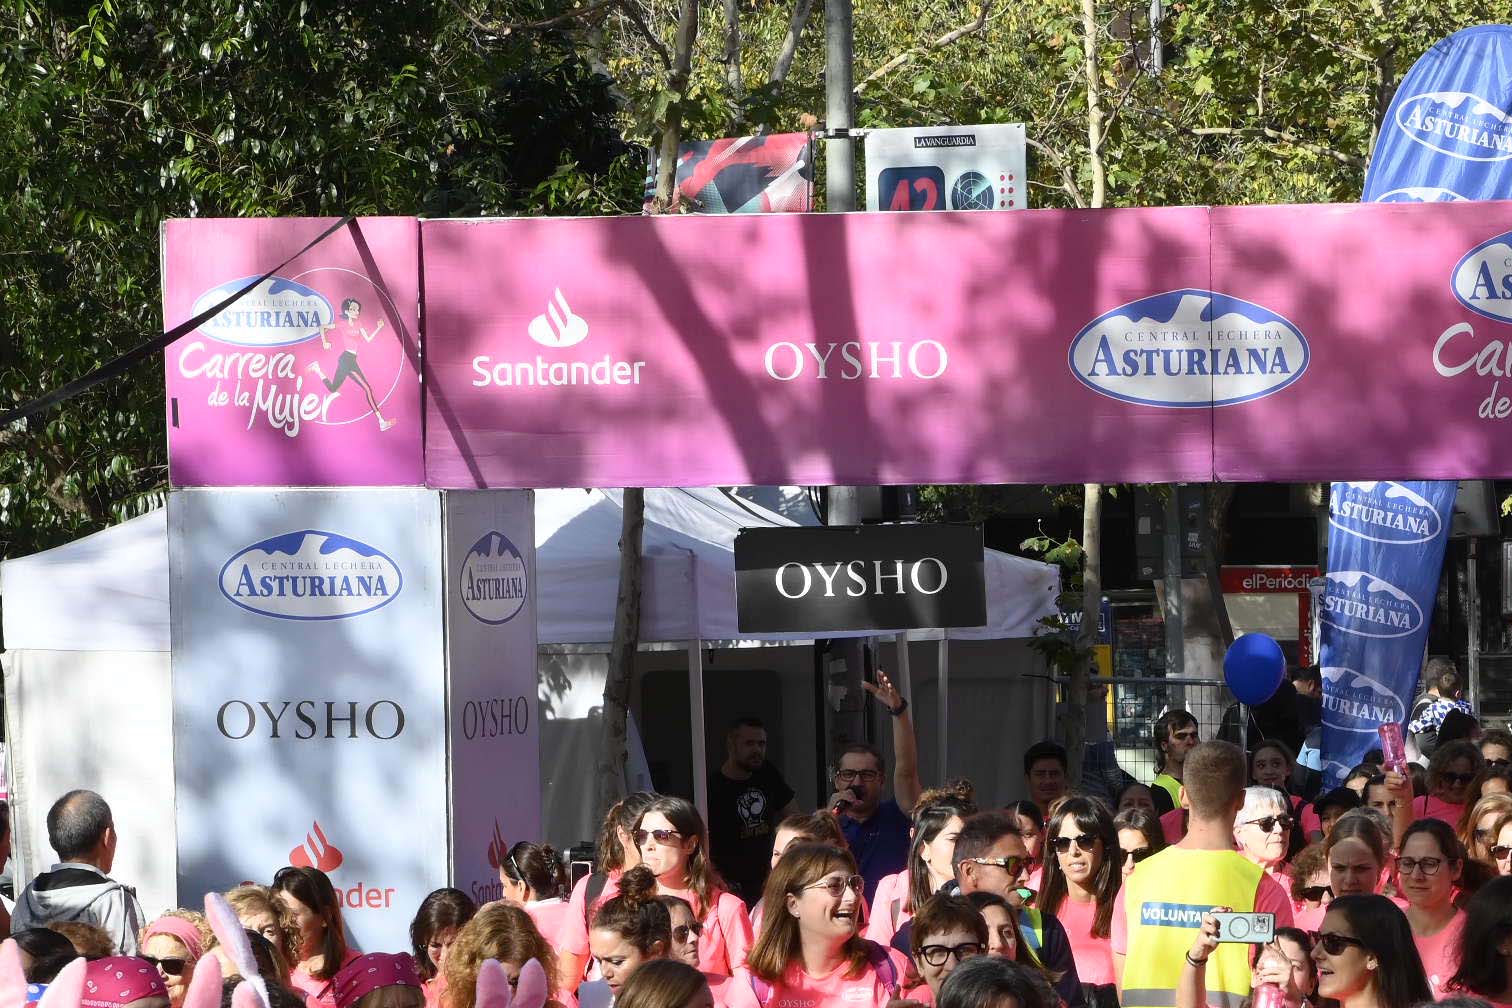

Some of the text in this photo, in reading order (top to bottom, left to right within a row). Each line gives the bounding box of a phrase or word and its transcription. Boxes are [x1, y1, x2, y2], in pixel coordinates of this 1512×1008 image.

[889, 176, 941, 212] 42
[1124, 329, 1282, 342] CENTRAL LECHERA
[179, 341, 297, 379] Carrera
[472, 353, 646, 386] Santander
[763, 340, 949, 381] OYSHO
[1088, 335, 1291, 377] ASTURIANA
[208, 376, 341, 438] de la Mujer
[1478, 381, 1512, 419] de
[1329, 490, 1430, 536] ASTURIANA
[234, 564, 389, 598] ASTURIANA
[261, 561, 383, 571] CENTRAL LECHERA
[466, 566, 523, 600] ASTURIANA
[776, 557, 948, 600] OYSHO
[216, 700, 405, 739] OYSHO
[463, 696, 528, 739] OYSHO
[778, 1000, 816, 1008] OYSHO
